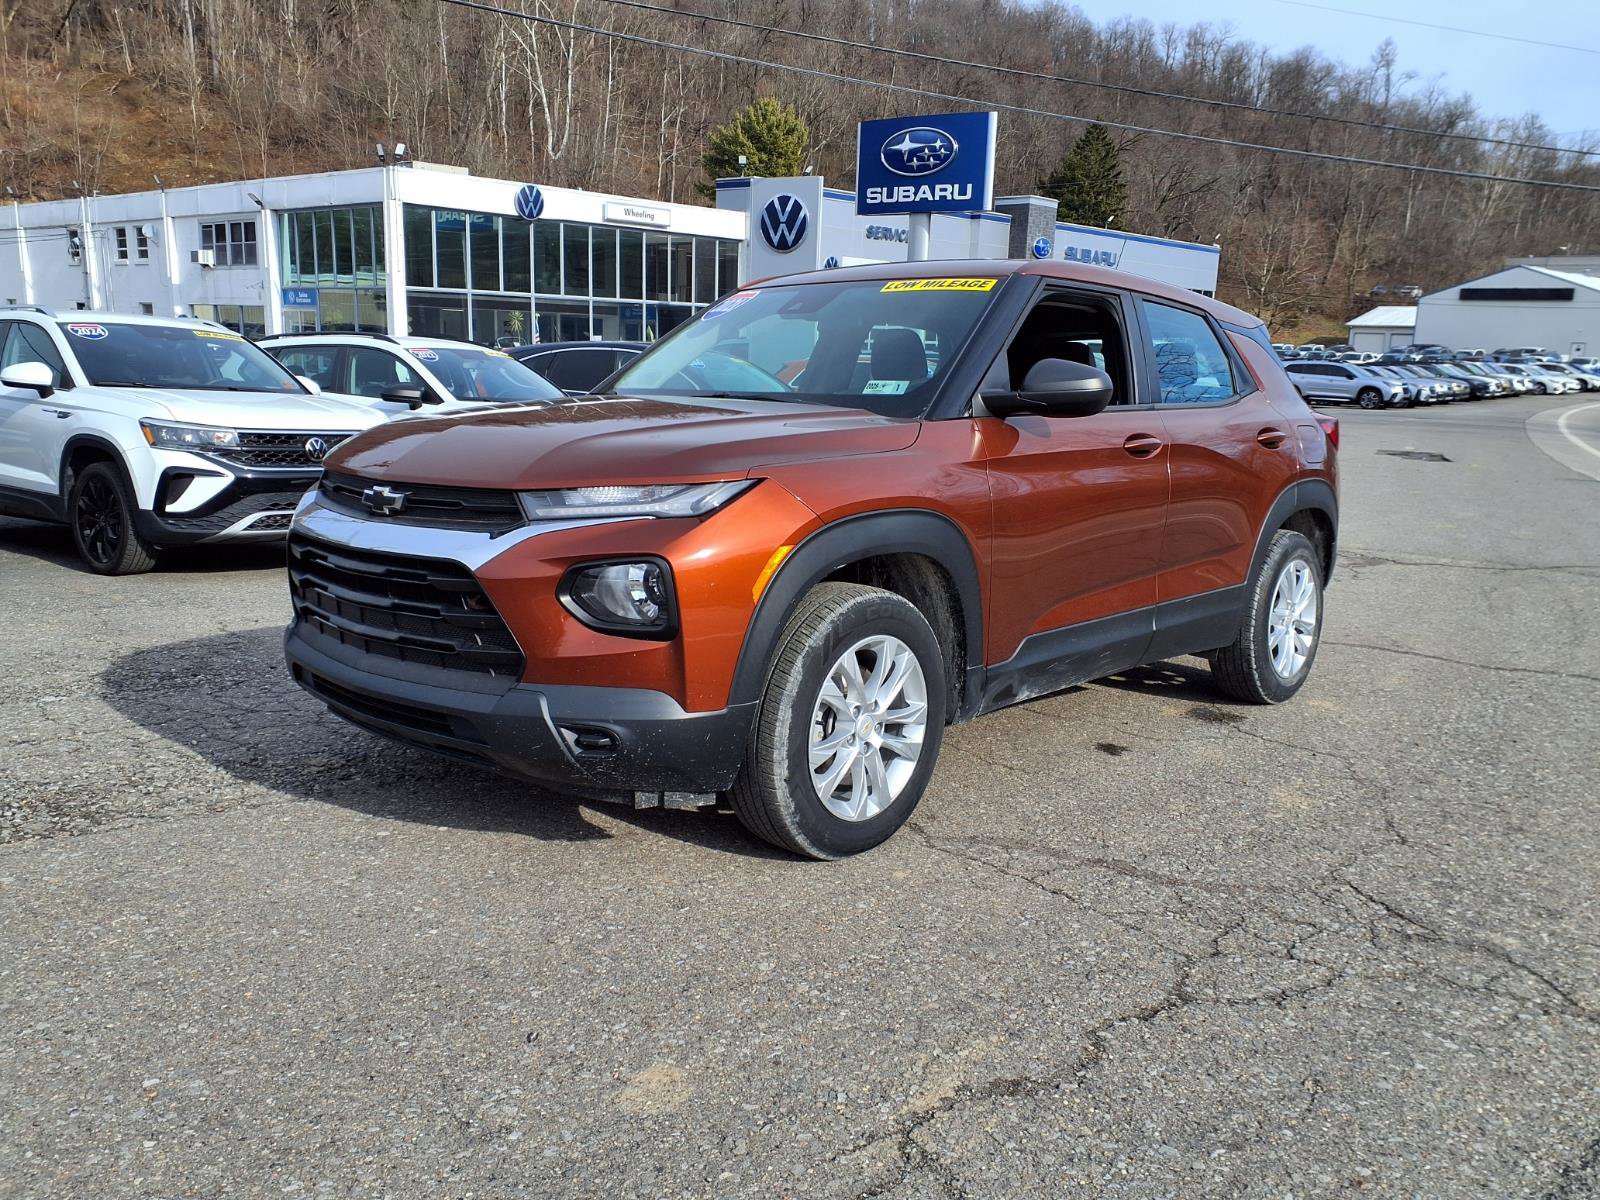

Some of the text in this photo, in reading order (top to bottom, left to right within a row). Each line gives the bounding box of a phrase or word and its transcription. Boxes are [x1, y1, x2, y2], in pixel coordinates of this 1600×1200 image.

[866, 184, 973, 204] SUBARU
[624, 208, 655, 221] Wheeling
[1064, 246, 1117, 267] SUBARU
[885, 280, 992, 290] LOW MILEAGE
[74, 327, 105, 336] 2024
